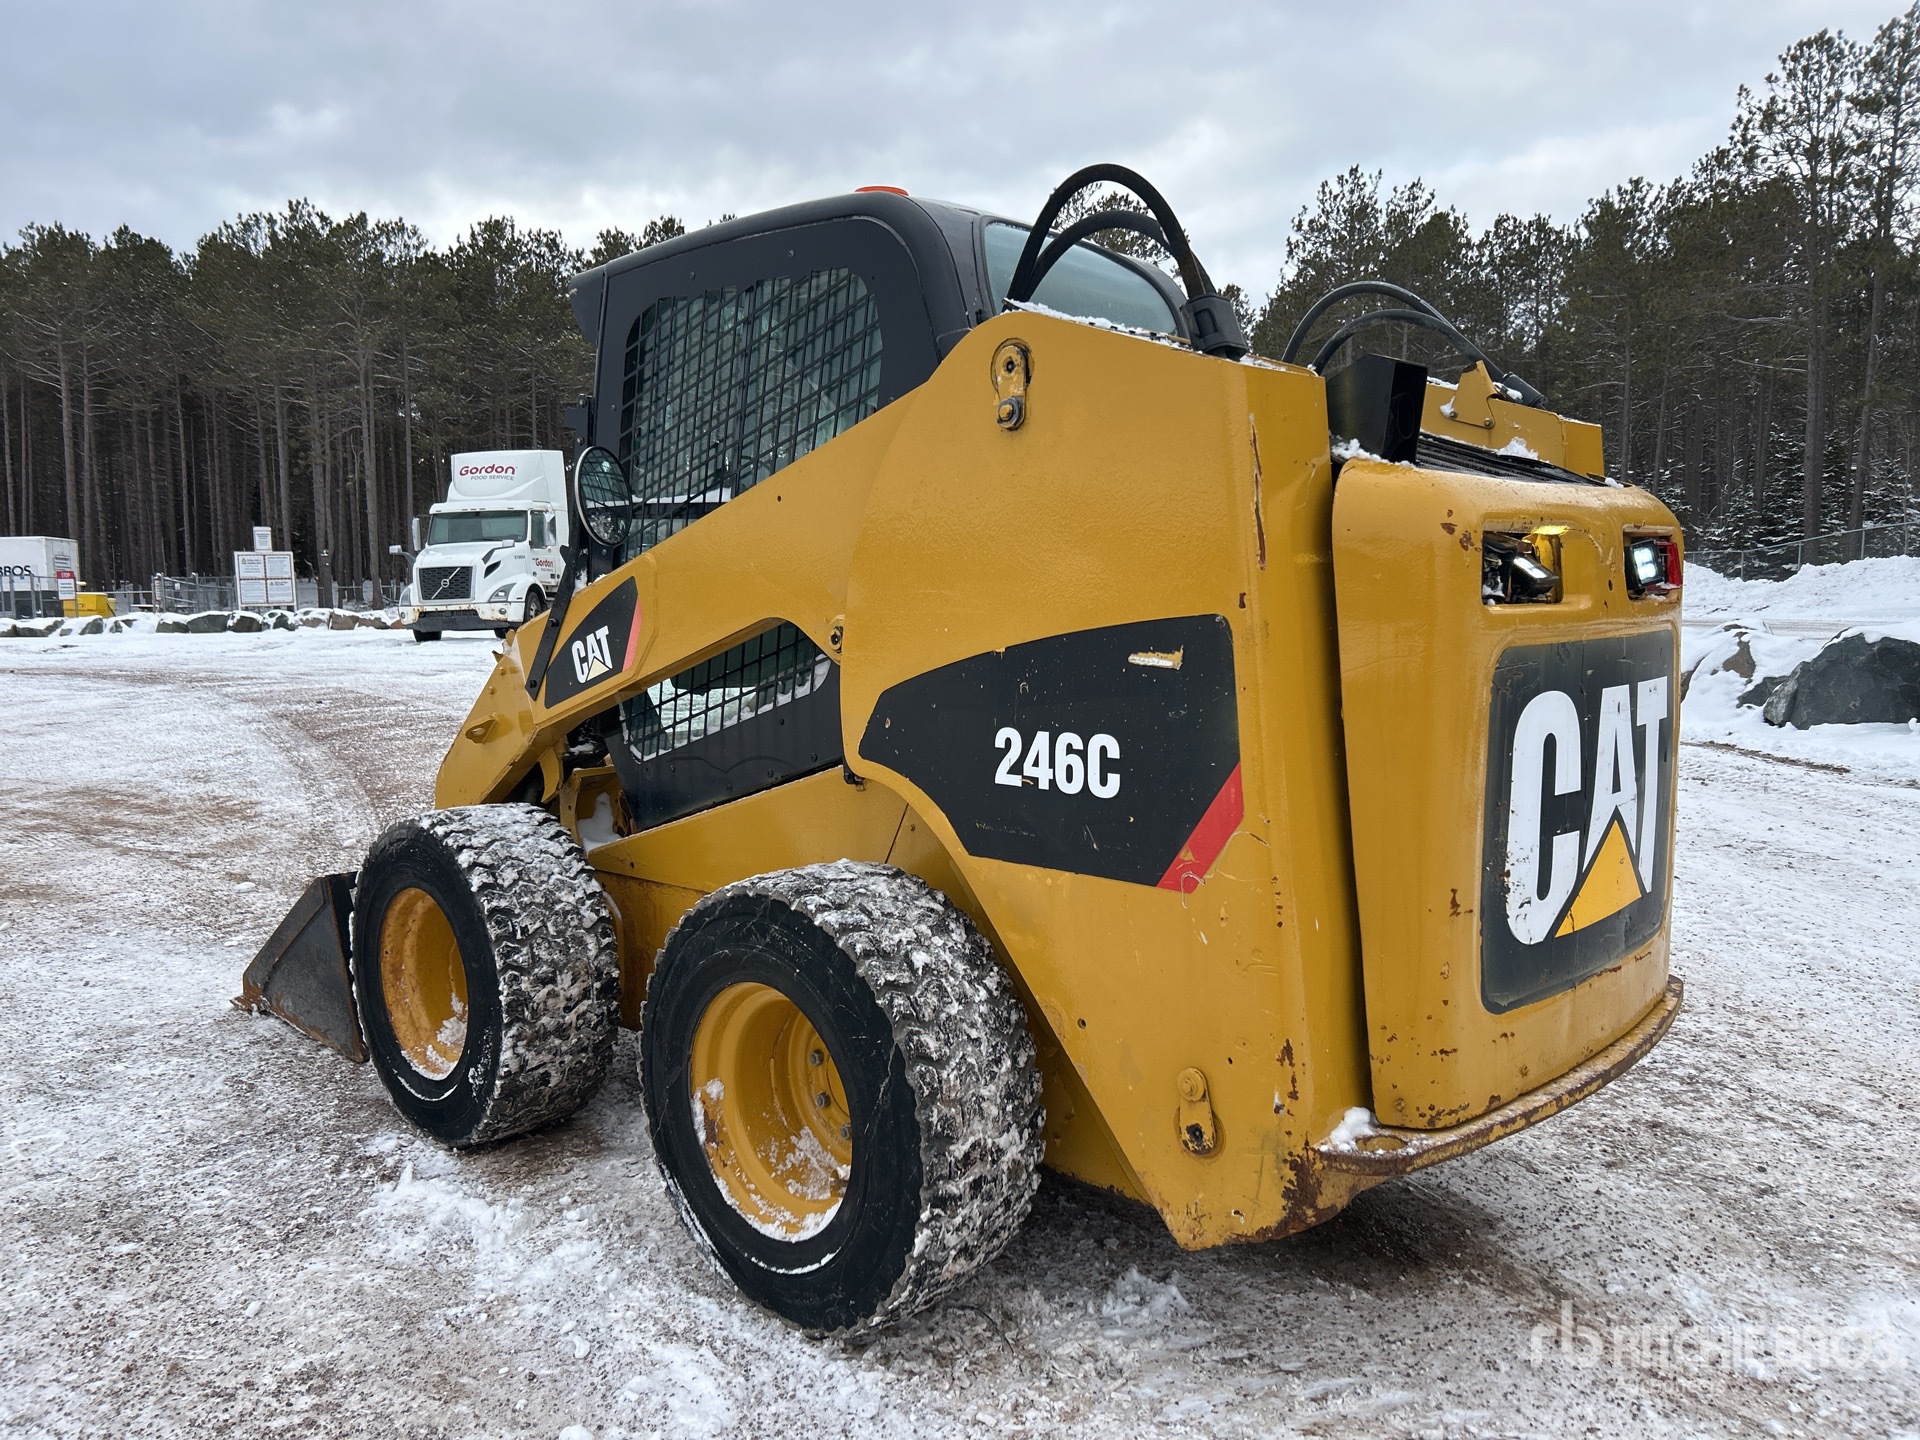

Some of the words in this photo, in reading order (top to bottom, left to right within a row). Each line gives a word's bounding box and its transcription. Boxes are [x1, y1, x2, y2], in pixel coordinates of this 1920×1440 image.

[459, 464, 516, 476] Gordon
[535, 557, 554, 568] Gordon
[571, 625, 613, 684] CAT
[994, 726, 1121, 799] 246C
[1505, 675, 1668, 946] CAT
